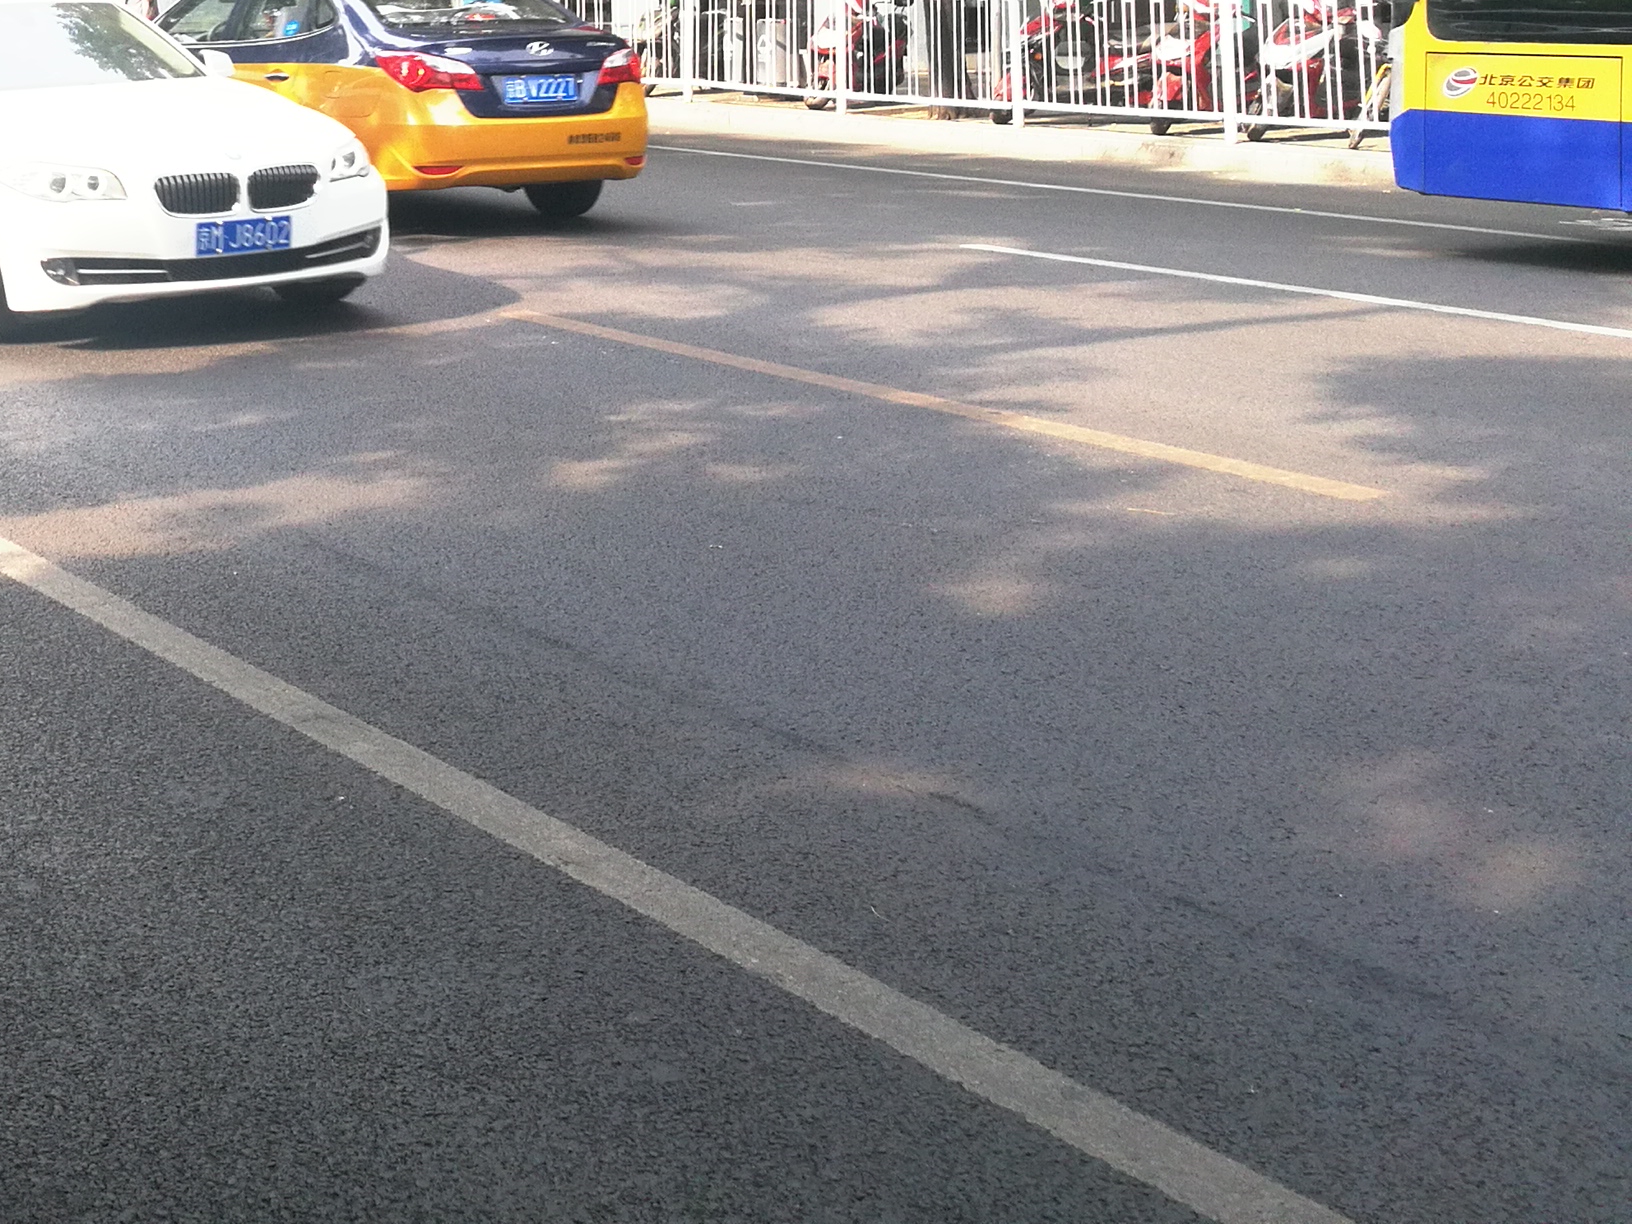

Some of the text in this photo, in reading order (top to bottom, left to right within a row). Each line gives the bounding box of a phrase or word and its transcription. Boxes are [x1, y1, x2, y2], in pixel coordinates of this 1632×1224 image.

[1479, 74, 1595, 89] 北京公交集团
[1486, 91, 1576, 112] 40222134
